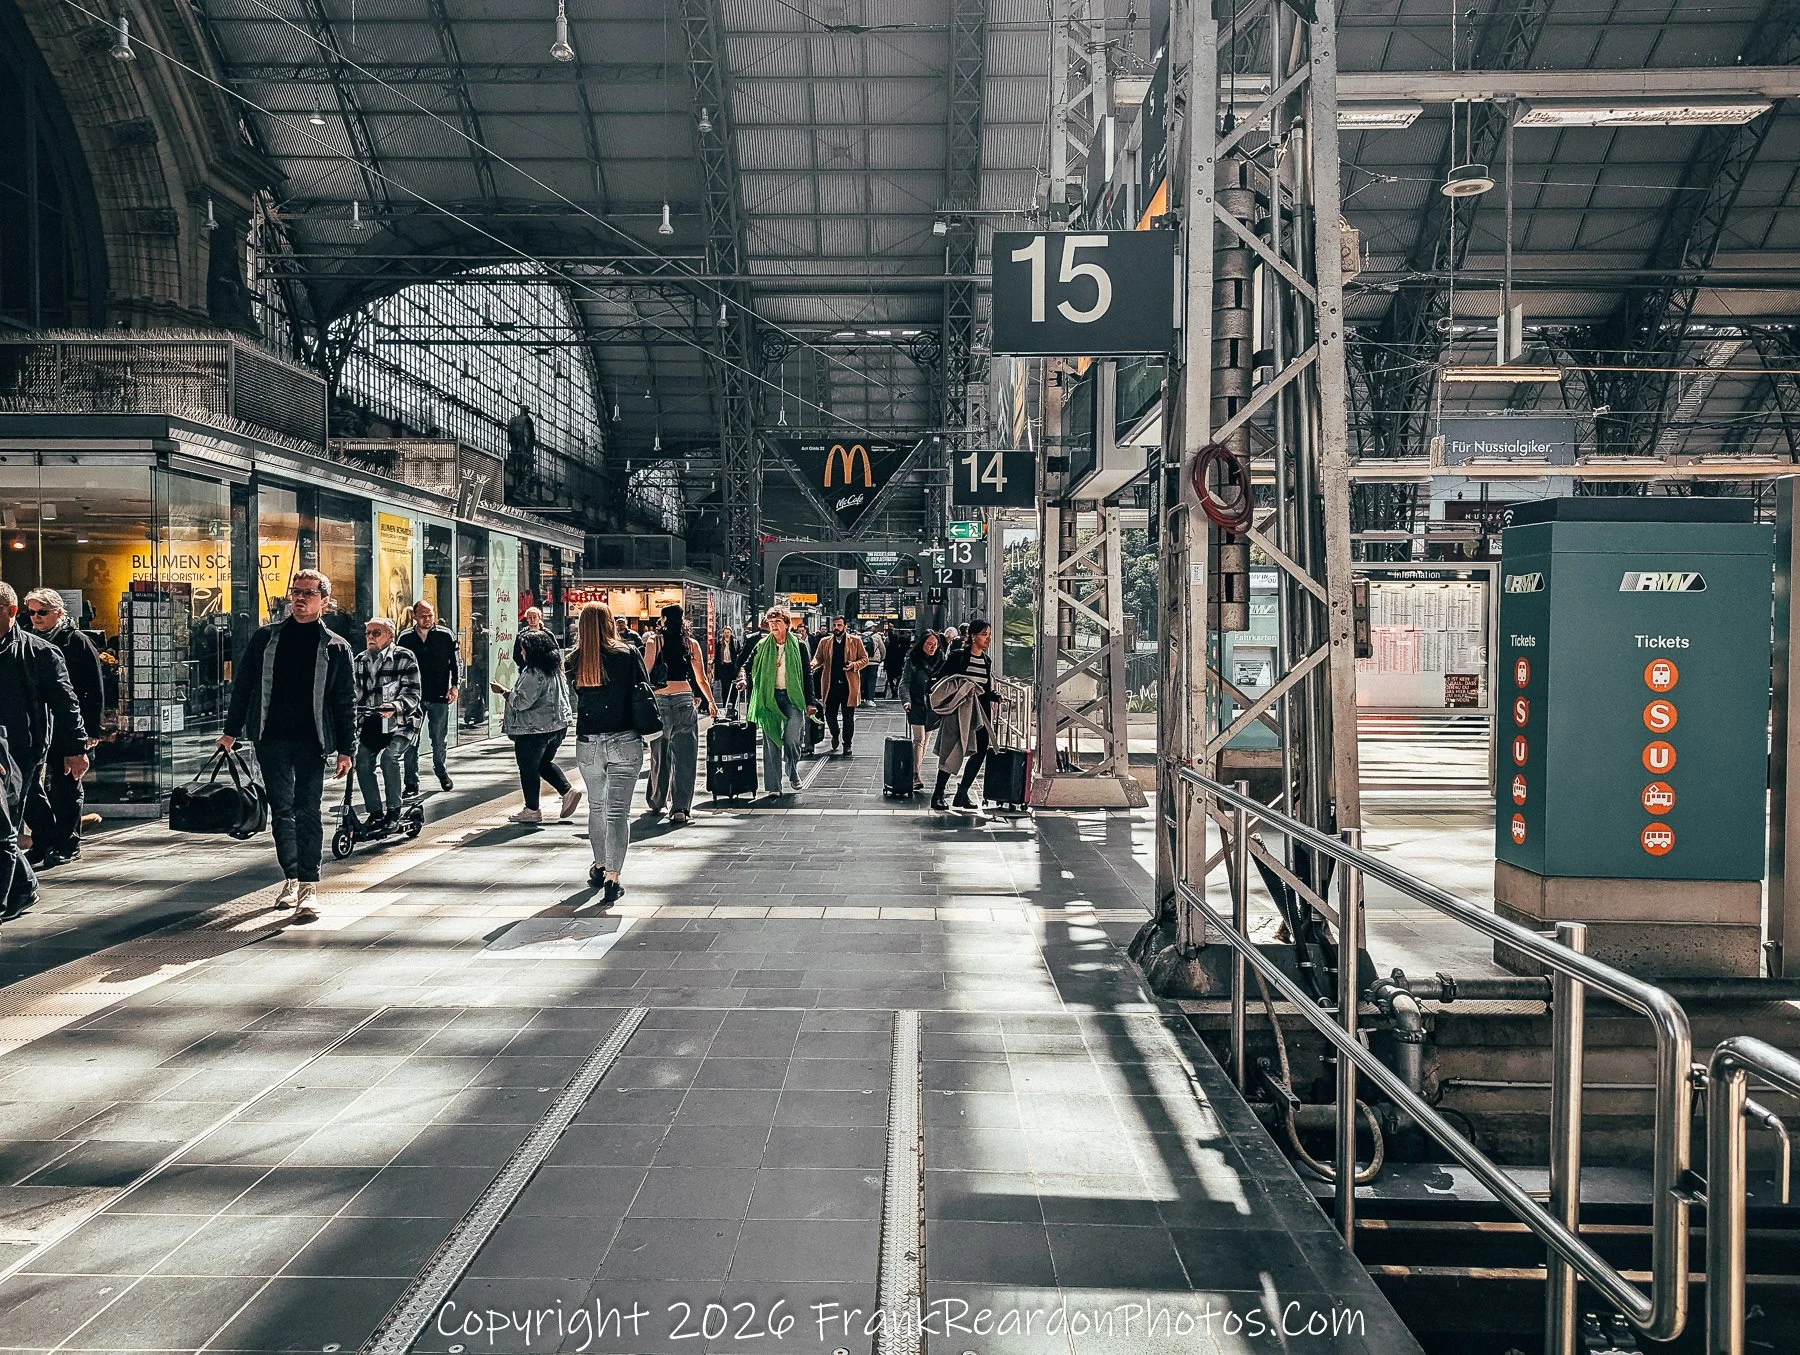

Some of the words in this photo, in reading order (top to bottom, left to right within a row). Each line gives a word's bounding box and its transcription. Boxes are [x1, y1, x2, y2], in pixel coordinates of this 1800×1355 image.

[1011, 235, 1112, 323] 15
[1452, 441, 1471, 453] Für
[1475, 440, 1553, 456] Nusstalgiker.
[961, 452, 1007, 492] 14
[132, 554, 200, 569] BLUMEN
[206, 554, 280, 569] SCDT
[948, 542, 972, 564] 13
[934, 568, 953, 584] 12
[1394, 570, 1440, 579] Information
[1633, 572, 1702, 592] RMV
[930, 587, 941, 597] 11
[1510, 634, 1536, 647] Tickets
[1635, 635, 1690, 649] Tickets
[1516, 700, 1526, 723] S
[1650, 704, 1670, 728] S
[1516, 741, 1525, 762] U
[1650, 748, 1669, 768] U
